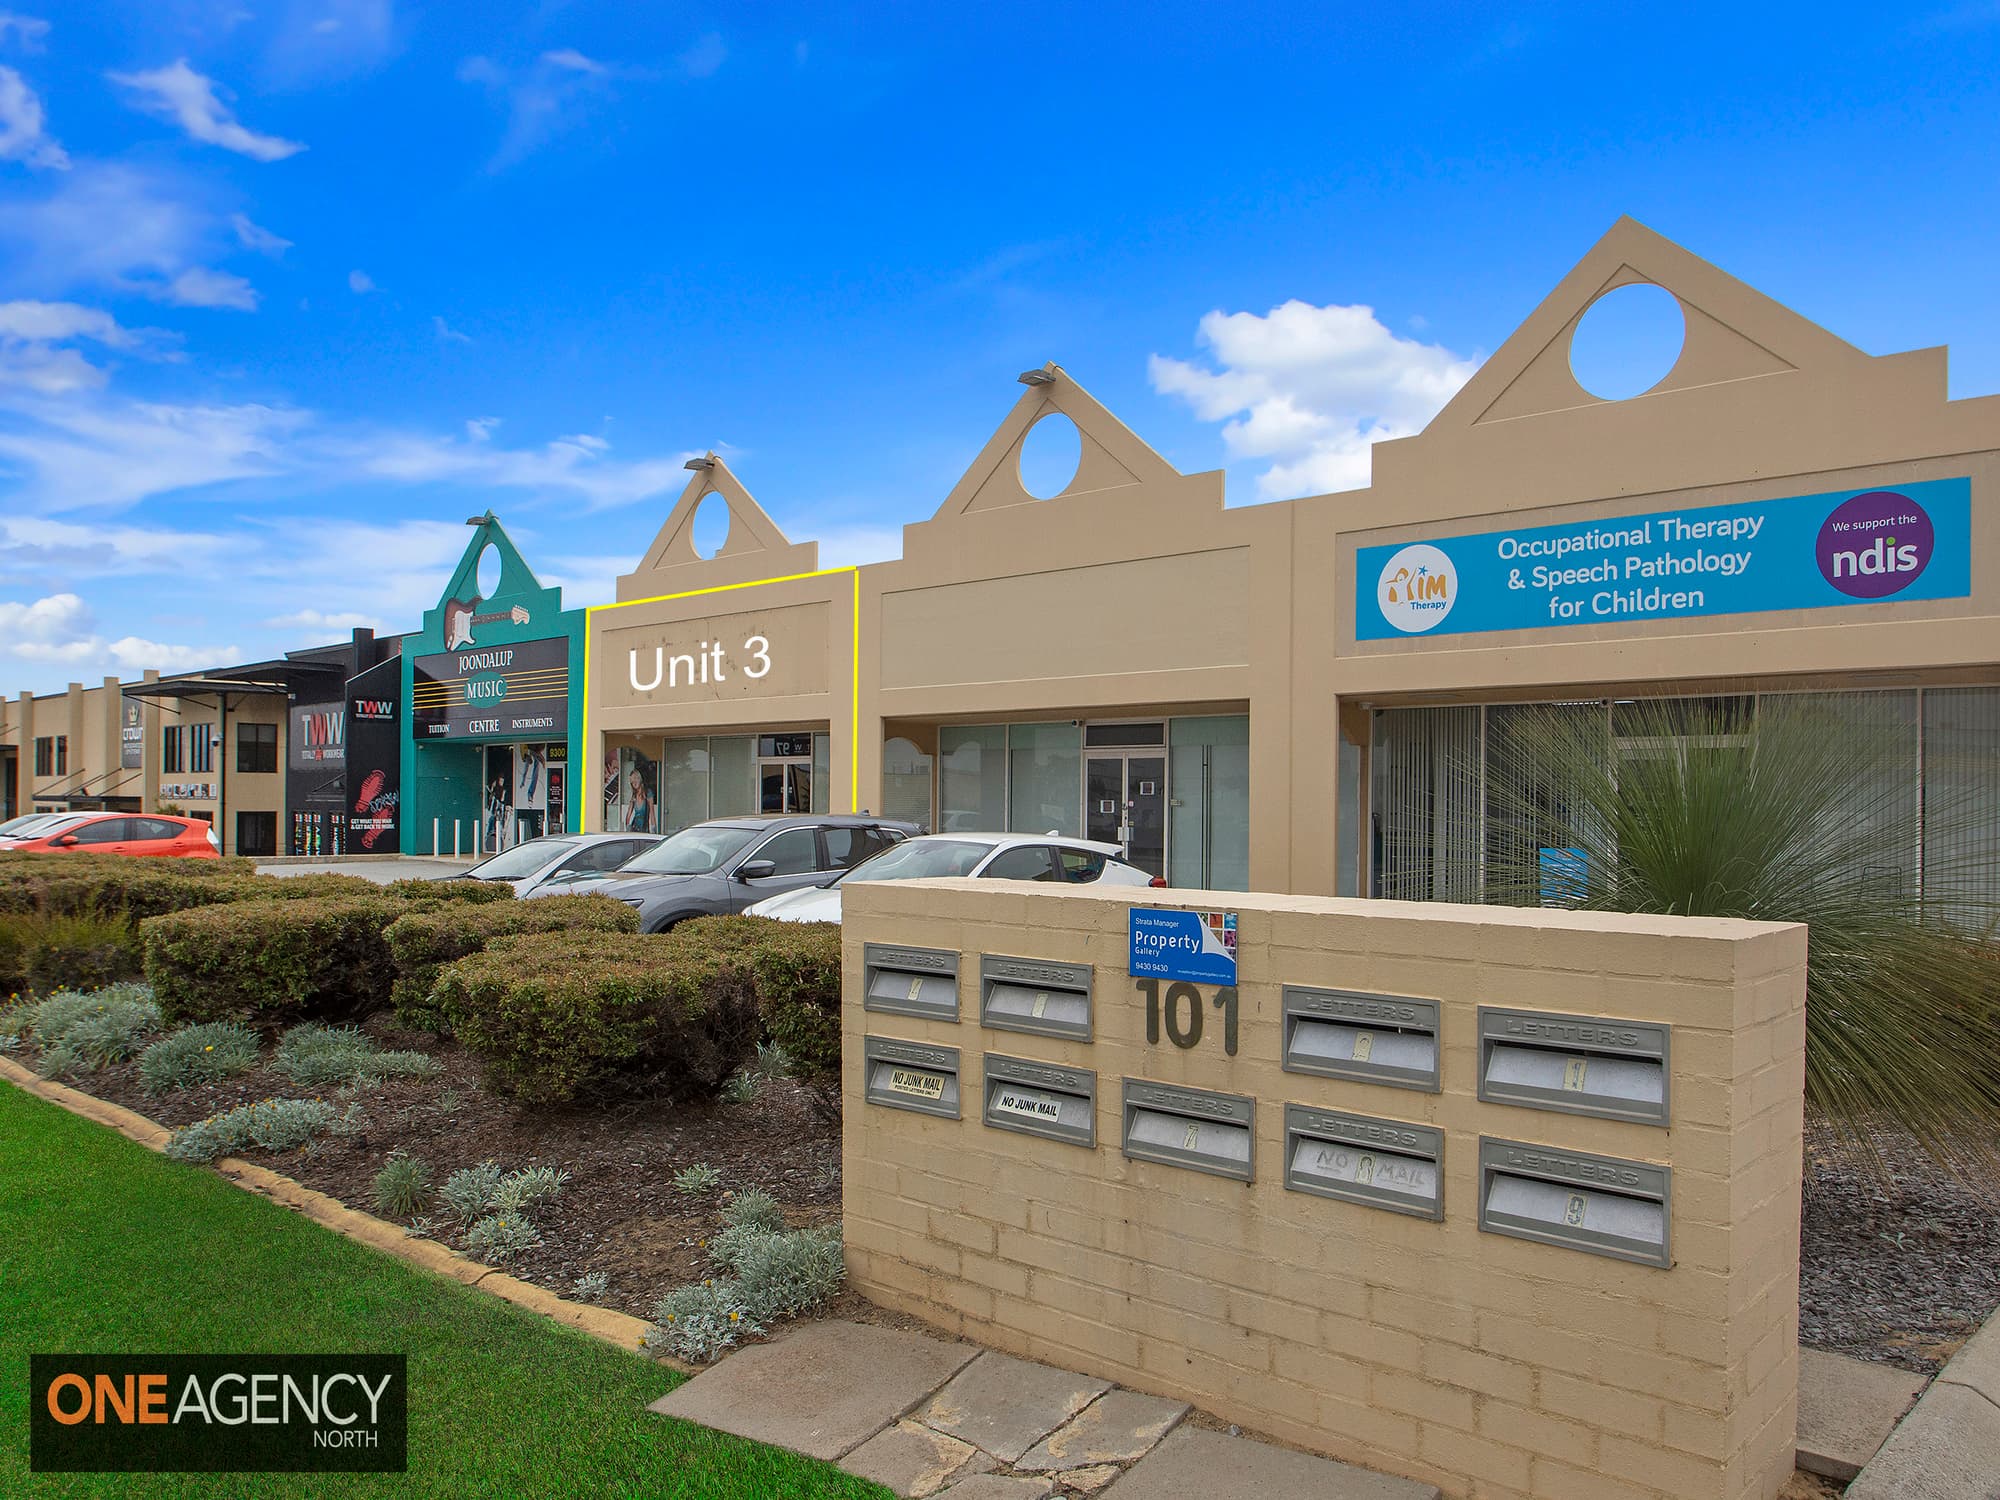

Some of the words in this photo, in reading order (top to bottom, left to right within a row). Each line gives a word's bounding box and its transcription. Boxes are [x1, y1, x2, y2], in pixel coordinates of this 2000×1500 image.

[1833, 522, 1850, 532] We
[1852, 517, 1895, 530] support
[1898, 515, 1917, 525] the
[1498, 521, 1650, 560] Occupational
[1658, 514, 1764, 544] Therapy
[1833, 536, 1918, 577] ndis
[1507, 569, 1526, 590] &
[1531, 558, 1618, 592] Speech
[1625, 548, 1752, 580] Pathology
[1410, 601, 1447, 610] Therapy
[1548, 596, 1585, 618] for
[1591, 588, 1704, 617] Children
[458, 650, 514, 674] JOONDALUP
[467, 679, 504, 699] MUSIC
[355, 700, 392, 714] TWW
[302, 711, 344, 746] TWW
[428, 724, 450, 734] TUITION
[469, 719, 500, 733] CENTRE
[512, 717, 553, 729] INSTRUMENTS
[1135, 917, 1152, 925] Strata
[1153, 919, 1179, 928] Manager
[1135, 946, 1160, 957] Gallery
[1136, 930, 1200, 954] Property
[1135, 962, 1151, 970] 9430
[1152, 964, 1168, 972] 9430
[1136, 979, 1239, 1056] 101
[1306, 996, 1415, 1021] LETTERS
[1506, 1019, 1639, 1047] LETTERS
[893, 1072, 904, 1084] NO
[904, 1073, 923, 1088] JUNK
[923, 1077, 940, 1091] MAIL
[1001, 1063, 1077, 1086] LETTERS
[1001, 1096, 1014, 1108] NO
[1015, 1099, 1037, 1113] JUNK
[1038, 1103, 1057, 1117] MAIL
[1143, 1088, 1233, 1116] LETTERS
[1308, 1116, 1417, 1147] LETTERS
[1317, 1150, 1348, 1168] NO
[1507, 1151, 1640, 1186] LETTERS
